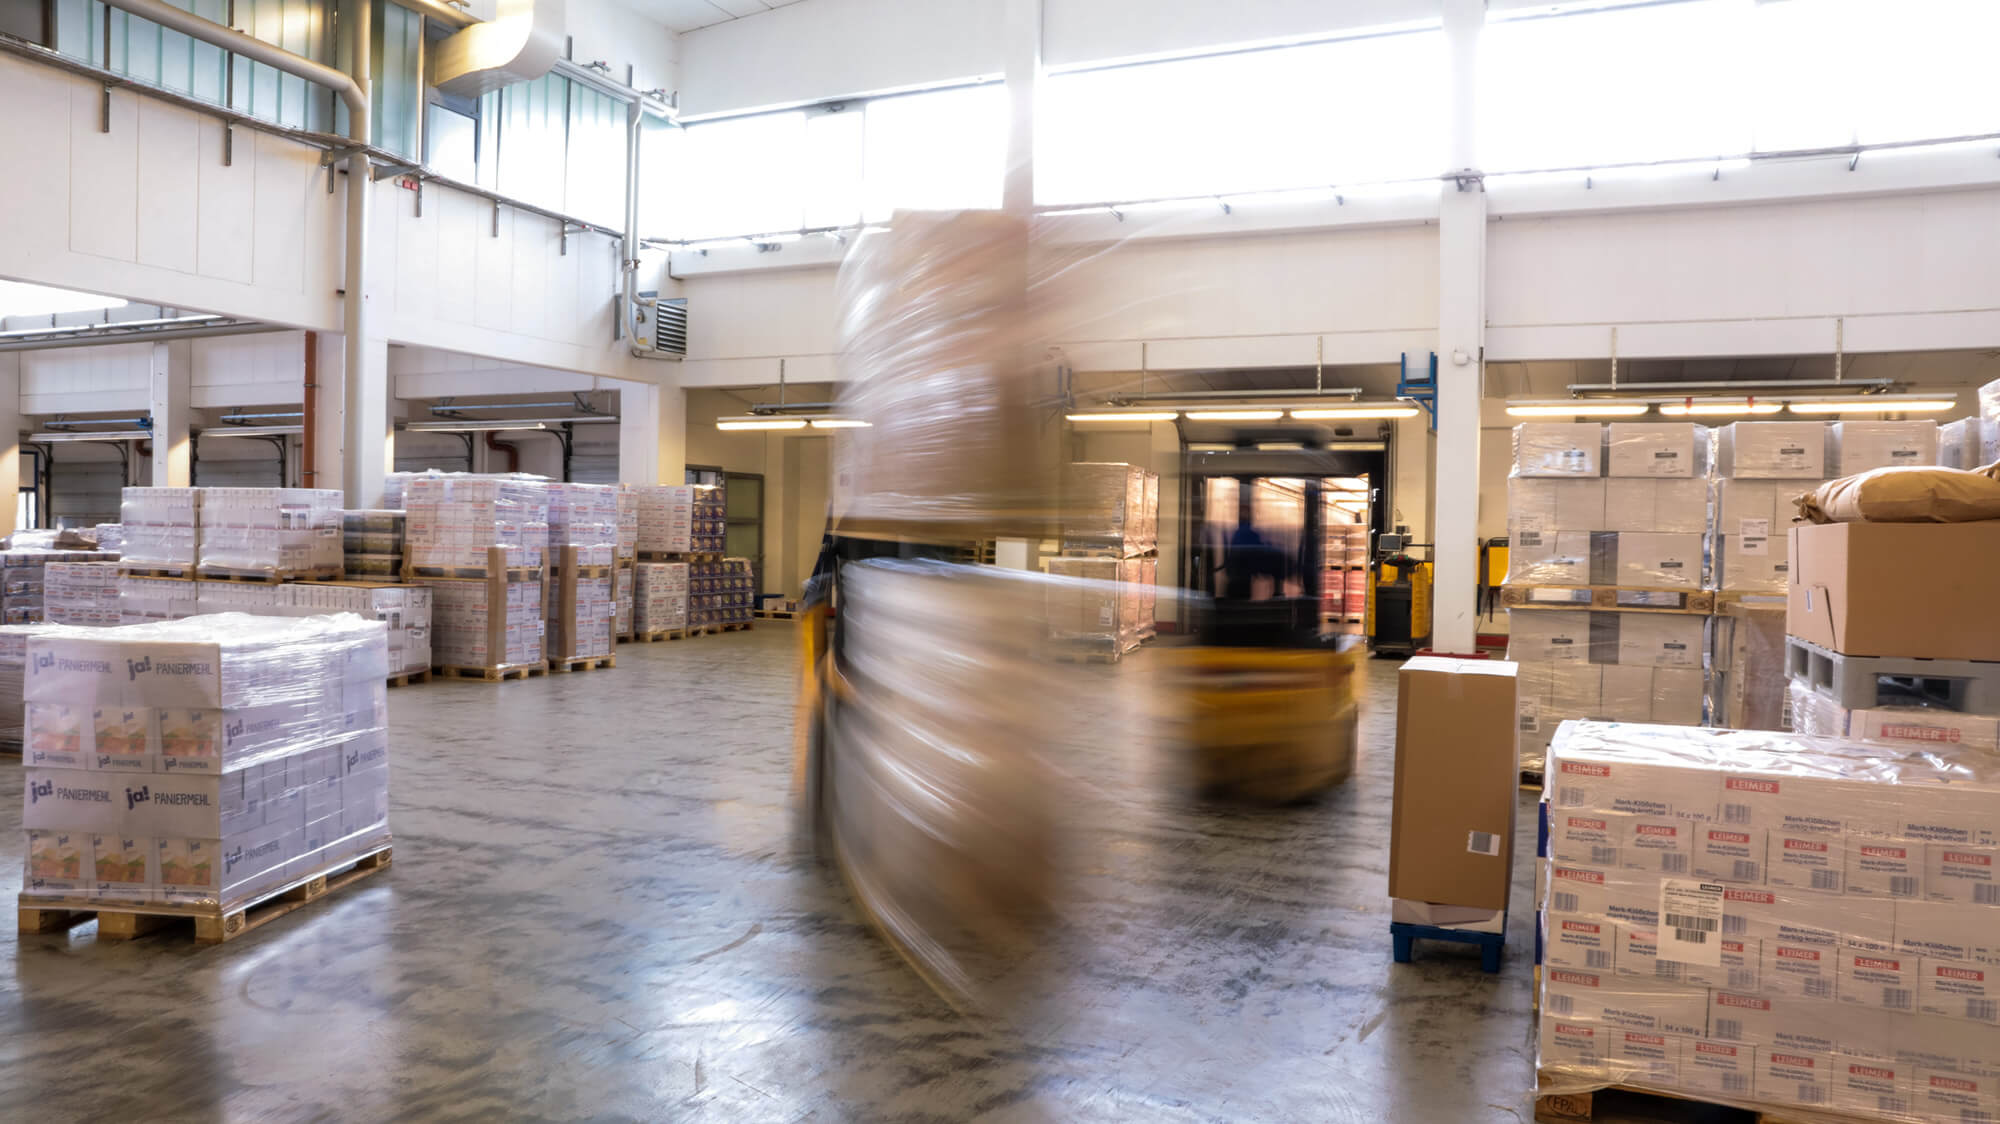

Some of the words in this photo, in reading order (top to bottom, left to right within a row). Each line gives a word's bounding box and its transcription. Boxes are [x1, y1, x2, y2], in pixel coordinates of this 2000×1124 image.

[33, 651, 54, 675] ja!
[58, 658, 113, 674] PANIERMEHL
[127, 656, 152, 681] ja!
[156, 662, 213, 676] PANIERMEHL
[226, 719, 243, 746] ja!
[1887, 727, 1942, 740] LEIMER
[346, 750, 358, 774] ja!
[1567, 764, 1606, 776] LEIMER
[1732, 779, 1773, 792] LEIMER
[31, 780, 53, 804] ja!
[57, 787, 112, 803] PANIERMEHL
[125, 785, 150, 810] ja!
[154, 793, 211, 807] PANIERMEHL
[1572, 818, 1602, 829] LEIMER
[1641, 826, 1672, 836] LEIMER
[1713, 831, 1744, 842] LEIMER
[1789, 839, 1822, 850] LEIMER
[1867, 847, 1902, 857] LEIMER
[224, 846, 242, 874] ja!
[1948, 853, 1984, 864] LEIMER
[1561, 870, 1598, 882] LEIMER
[1728, 891, 1768, 902] LEIMER
[1566, 922, 1596, 933] LEIMER
[1782, 949, 1814, 959] LEIMER
[1860, 958, 1894, 969] LEIMER
[1556, 973, 1593, 986] LEIMER
[1942, 969, 1978, 980] LEIMER
[1724, 994, 1763, 1009] LEIMER
[1776, 1055, 1808, 1066] LEIMER
[1855, 1066, 1888, 1079] LEIMER
[1936, 1077, 1971, 1089] LEIMER
